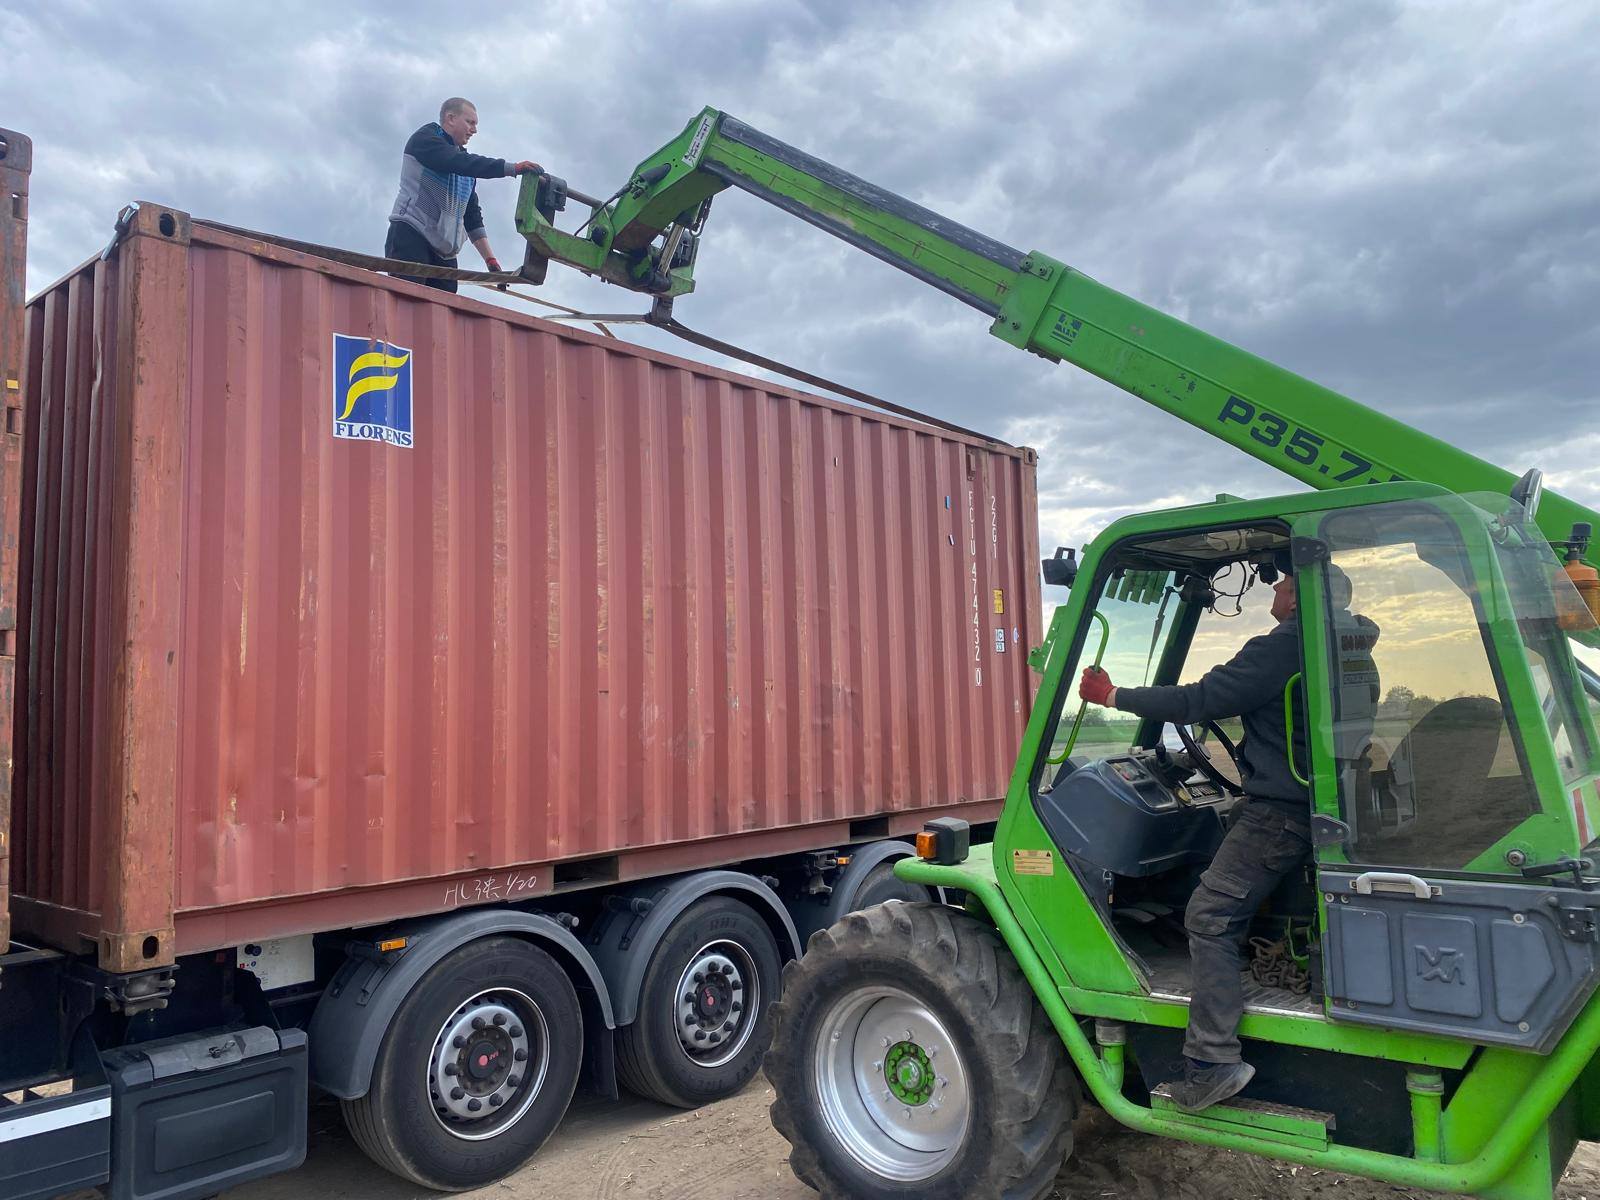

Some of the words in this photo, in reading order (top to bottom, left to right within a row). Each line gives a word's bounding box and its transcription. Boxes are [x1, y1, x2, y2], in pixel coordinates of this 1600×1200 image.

[335, 422, 412, 446] FLORENS
[1217, 395, 1406, 485] P35.7
[968, 490, 976, 556] FCIU
[971, 562, 981, 661] 474432
